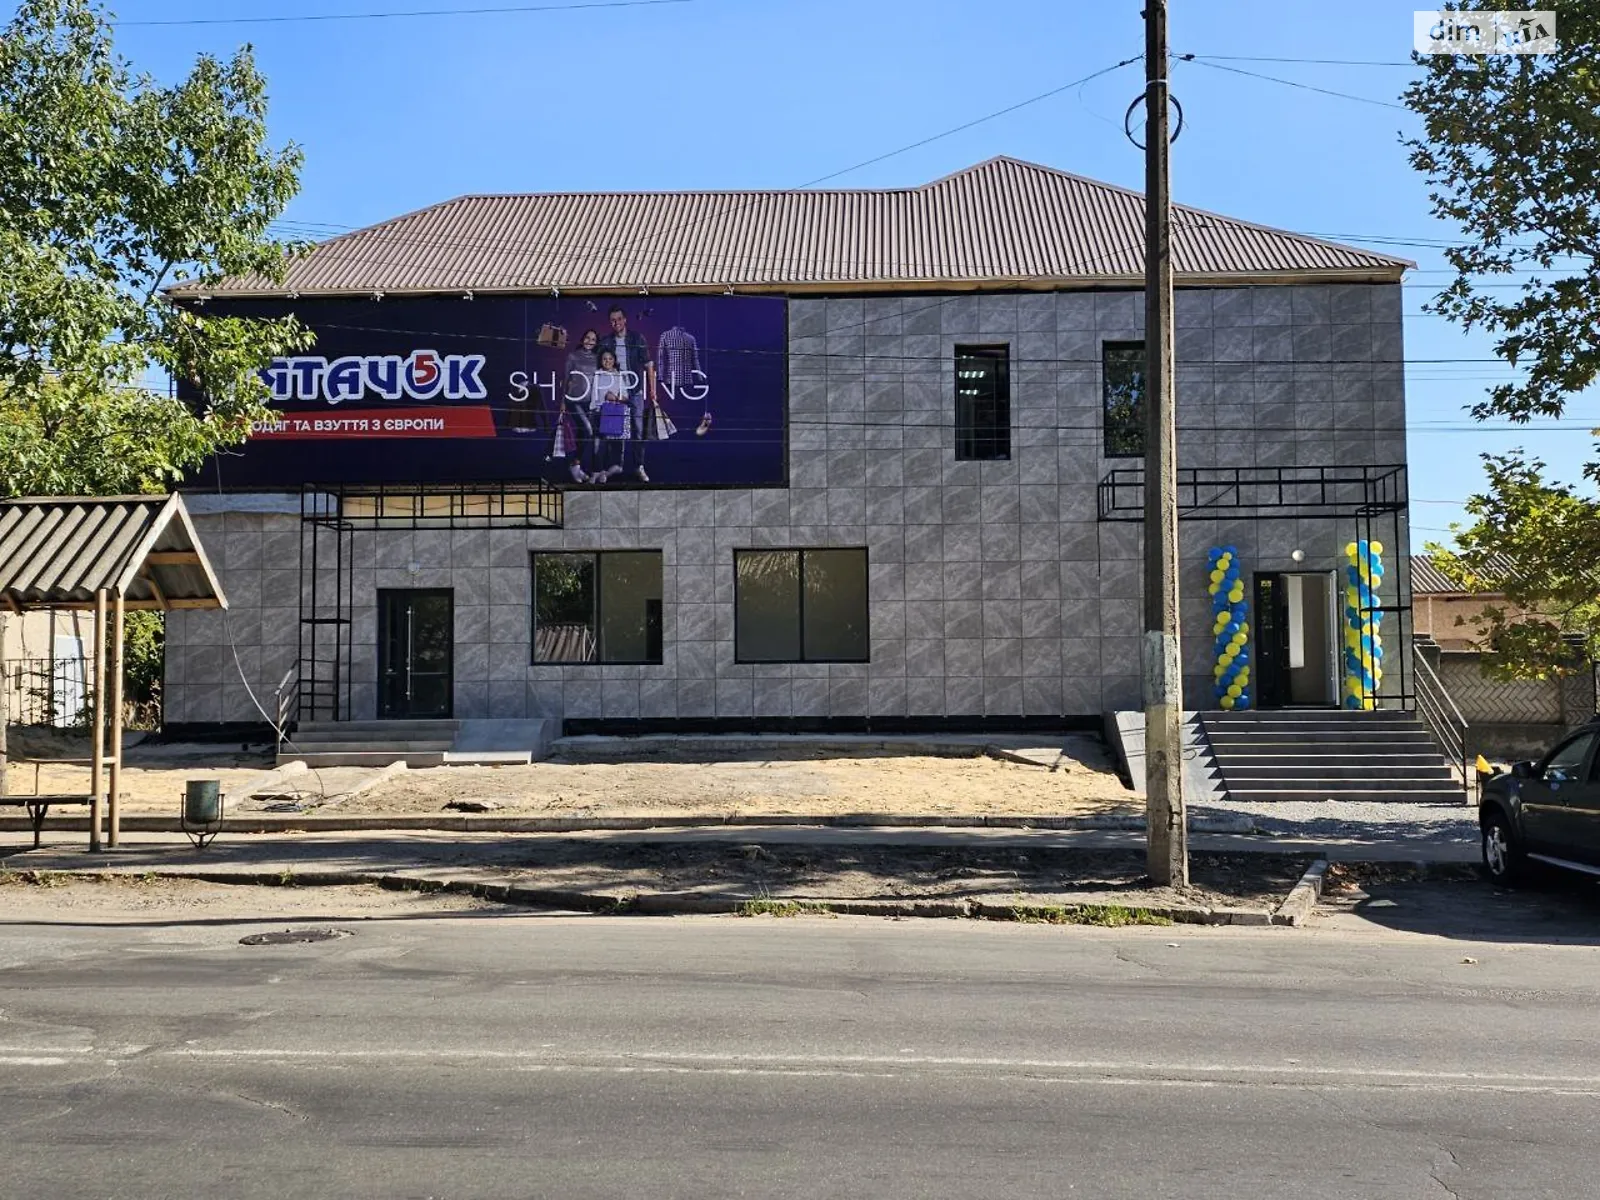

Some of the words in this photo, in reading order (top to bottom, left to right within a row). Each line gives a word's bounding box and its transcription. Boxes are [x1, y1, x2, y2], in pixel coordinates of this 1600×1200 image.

[508, 370, 710, 402] SHOPPING
[294, 420, 311, 431] ТА
[315, 419, 369, 431] ВЗУТТЯ
[372, 419, 380, 431] З
[384, 418, 444, 431] ЄВРОПИ
